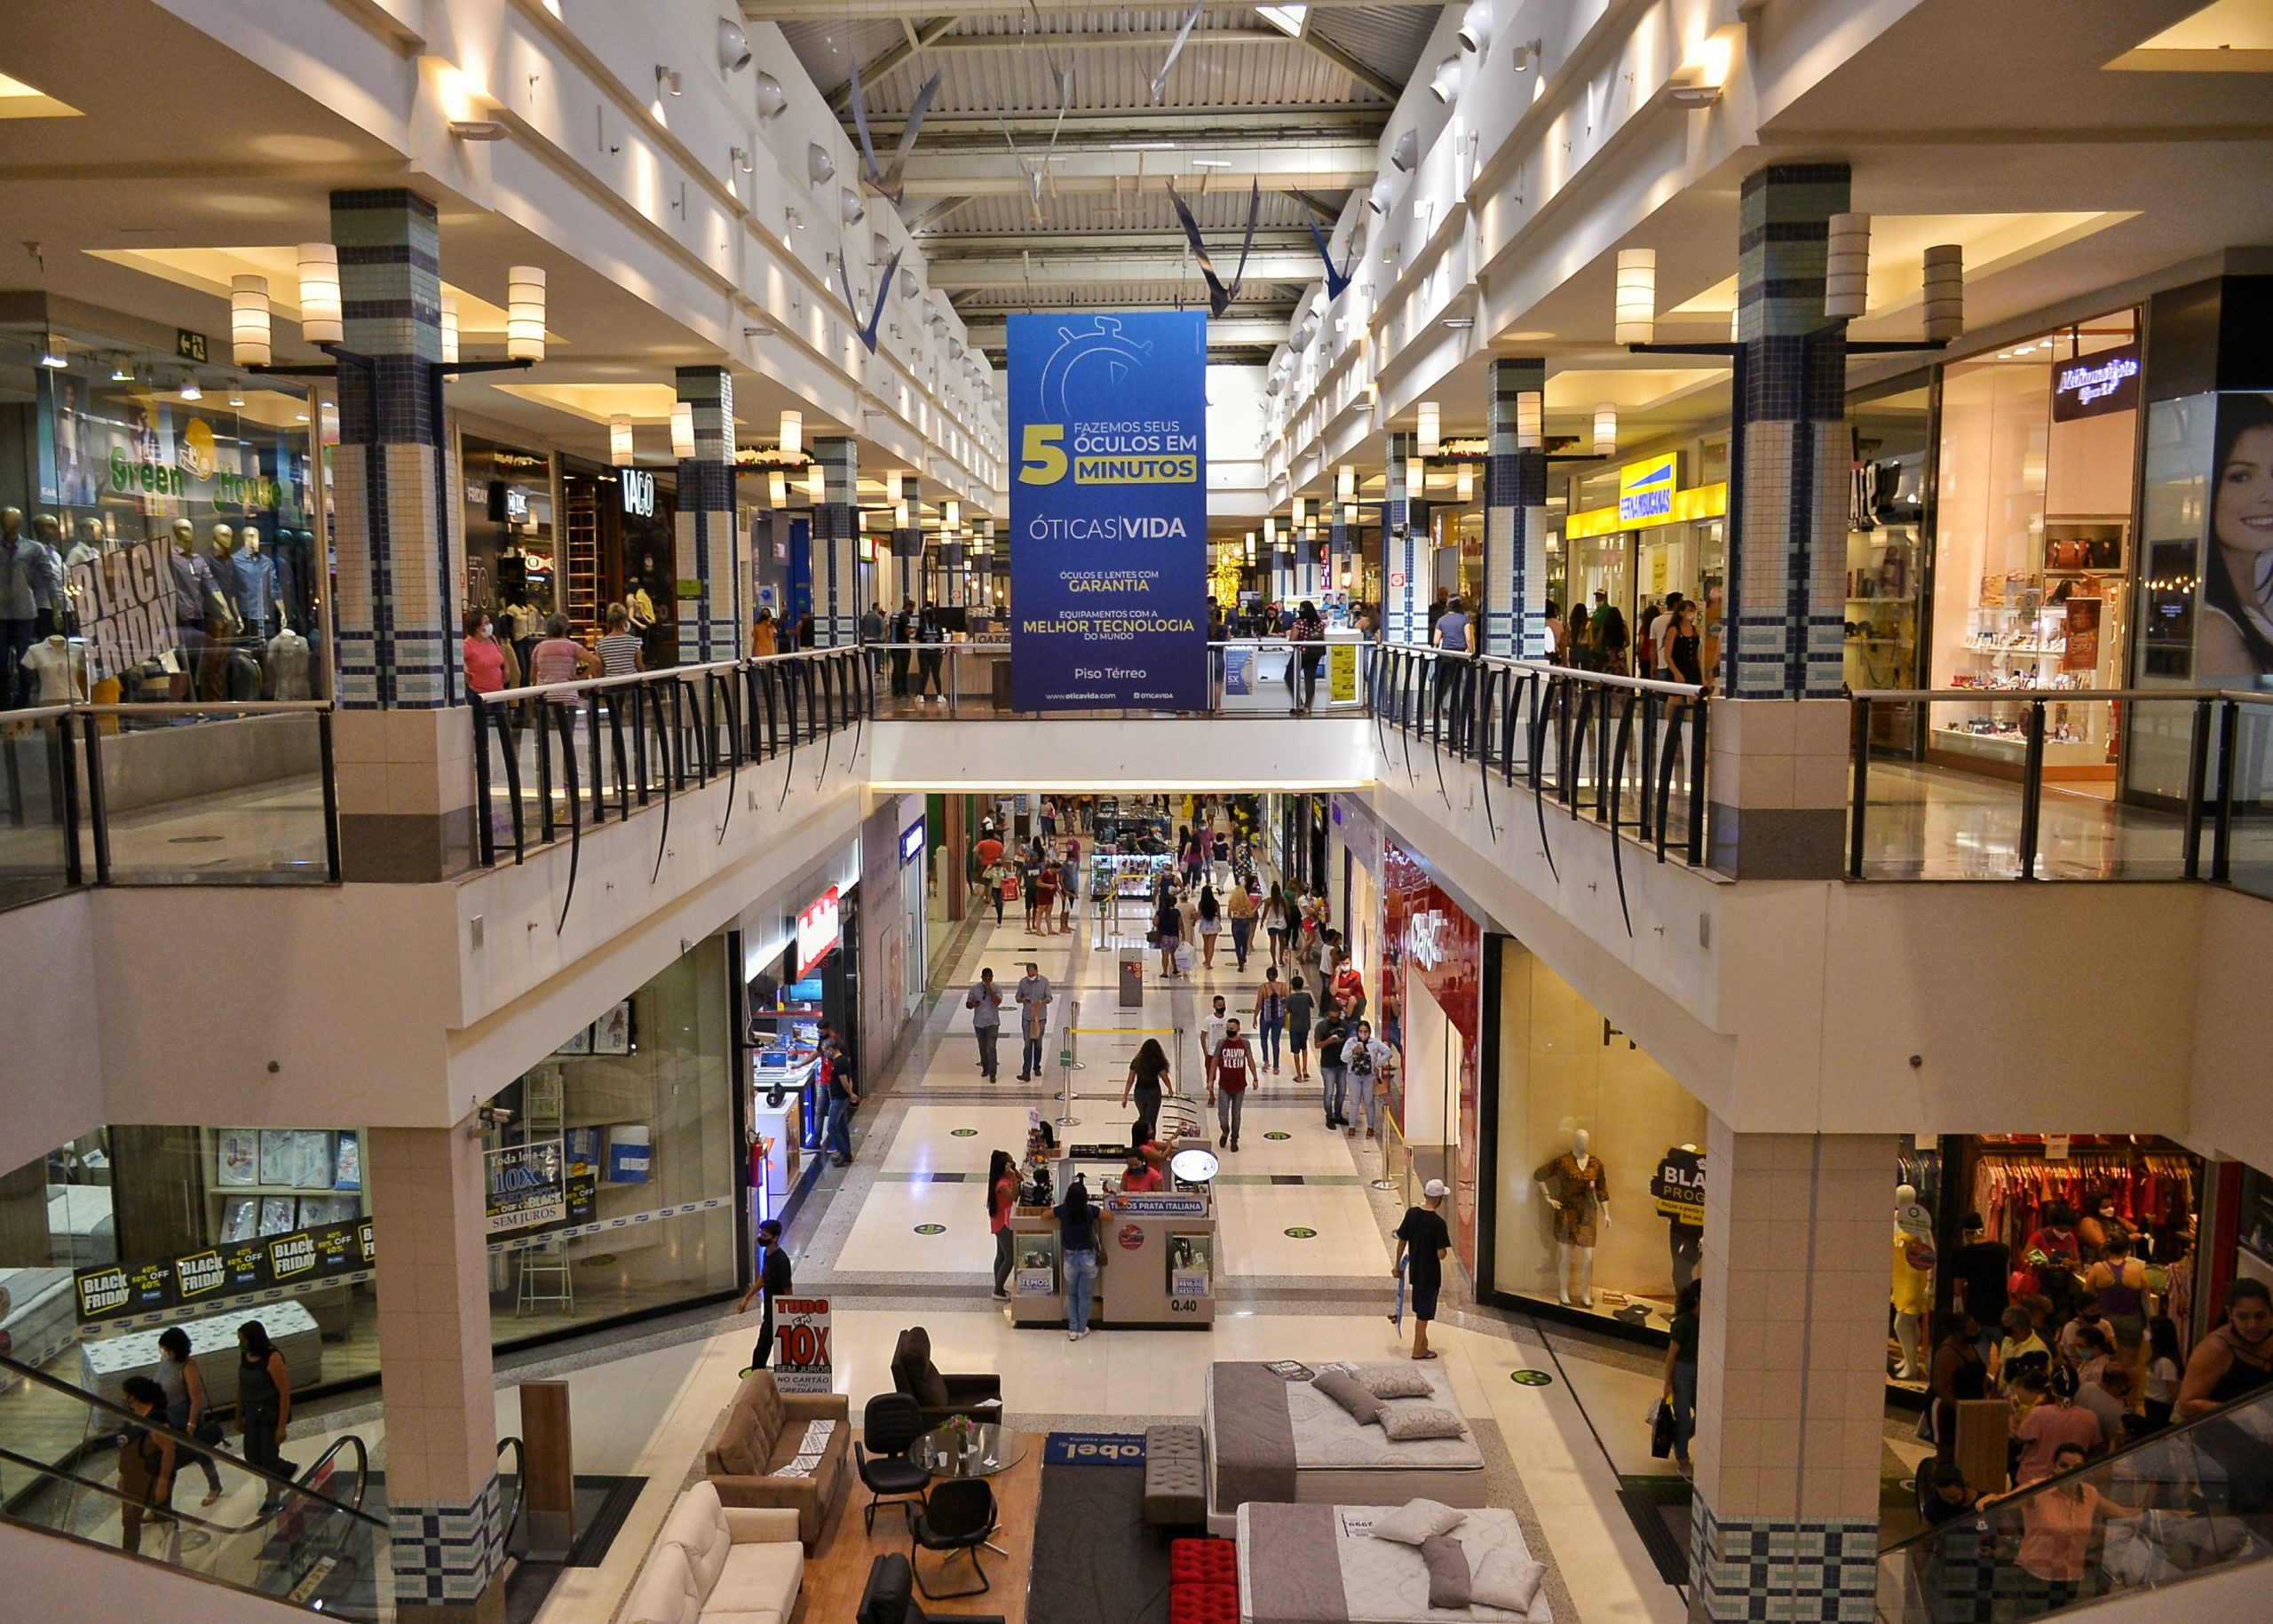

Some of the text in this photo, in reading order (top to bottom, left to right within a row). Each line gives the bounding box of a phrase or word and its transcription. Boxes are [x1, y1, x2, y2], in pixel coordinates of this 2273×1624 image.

[1074, 421, 1179, 433] FAZEMOS SEUS
[1074, 433, 1197, 452] ÓCULOS EM
[1018, 424, 1068, 485] 5
[1079, 459, 1193, 479] MINUTOS
[110, 446, 282, 512] Green House
[622, 469, 653, 518] TACO
[1122, 517, 1187, 538] VIDA
[71, 536, 177, 623] BLACK
[1059, 571, 1096, 580] ÓCULOS
[1068, 579, 1150, 592] GARANTIA
[1059, 610, 1128, 620] EQUIPAMENTOS
[1024, 619, 1195, 633] MELHOR TECNOLOGIA
[81, 591, 179, 684] FRIDAY
[978, 635, 1010, 644] OAKB
[1075, 667, 1146, 679] Piso Térreo
[1222, 1048, 1245, 1058] CALVIN
[1223, 1058, 1244, 1068] KLEIN
[490, 1153, 516, 1167] Toda
[491, 1163, 540, 1194] 10X
[1664, 1166, 1705, 1189] BLA
[579, 1188, 594, 1197] OFF
[1663, 1185, 1705, 1202] PROG
[1110, 1201, 1201, 1210] TOS PRATA ITALIANA
[493, 1208, 556, 1229] SEM JUROS
[334, 1235, 352, 1245] OFF
[273, 1240, 314, 1259] BLACK
[327, 1245, 345, 1255] 60%
[244, 1252, 263, 1263] OFF
[275, 1252, 317, 1272] FRIDAY
[181, 1256, 223, 1276] BLACK
[236, 1262, 255, 1271] 60%
[149, 1270, 169, 1279] OFF
[182, 1271, 226, 1292] FRIDAY
[83, 1272, 128, 1294] BLACK
[141, 1279, 162, 1290] 60%
[84, 1288, 131, 1310] FRIDAY
[1171, 1300, 1197, 1311] Q.40
[774, 1299, 828, 1314] TUDO
[792, 1313, 812, 1326] EM
[774, 1324, 831, 1365] 10X
[775, 1365, 831, 1374] SEM JUROS
